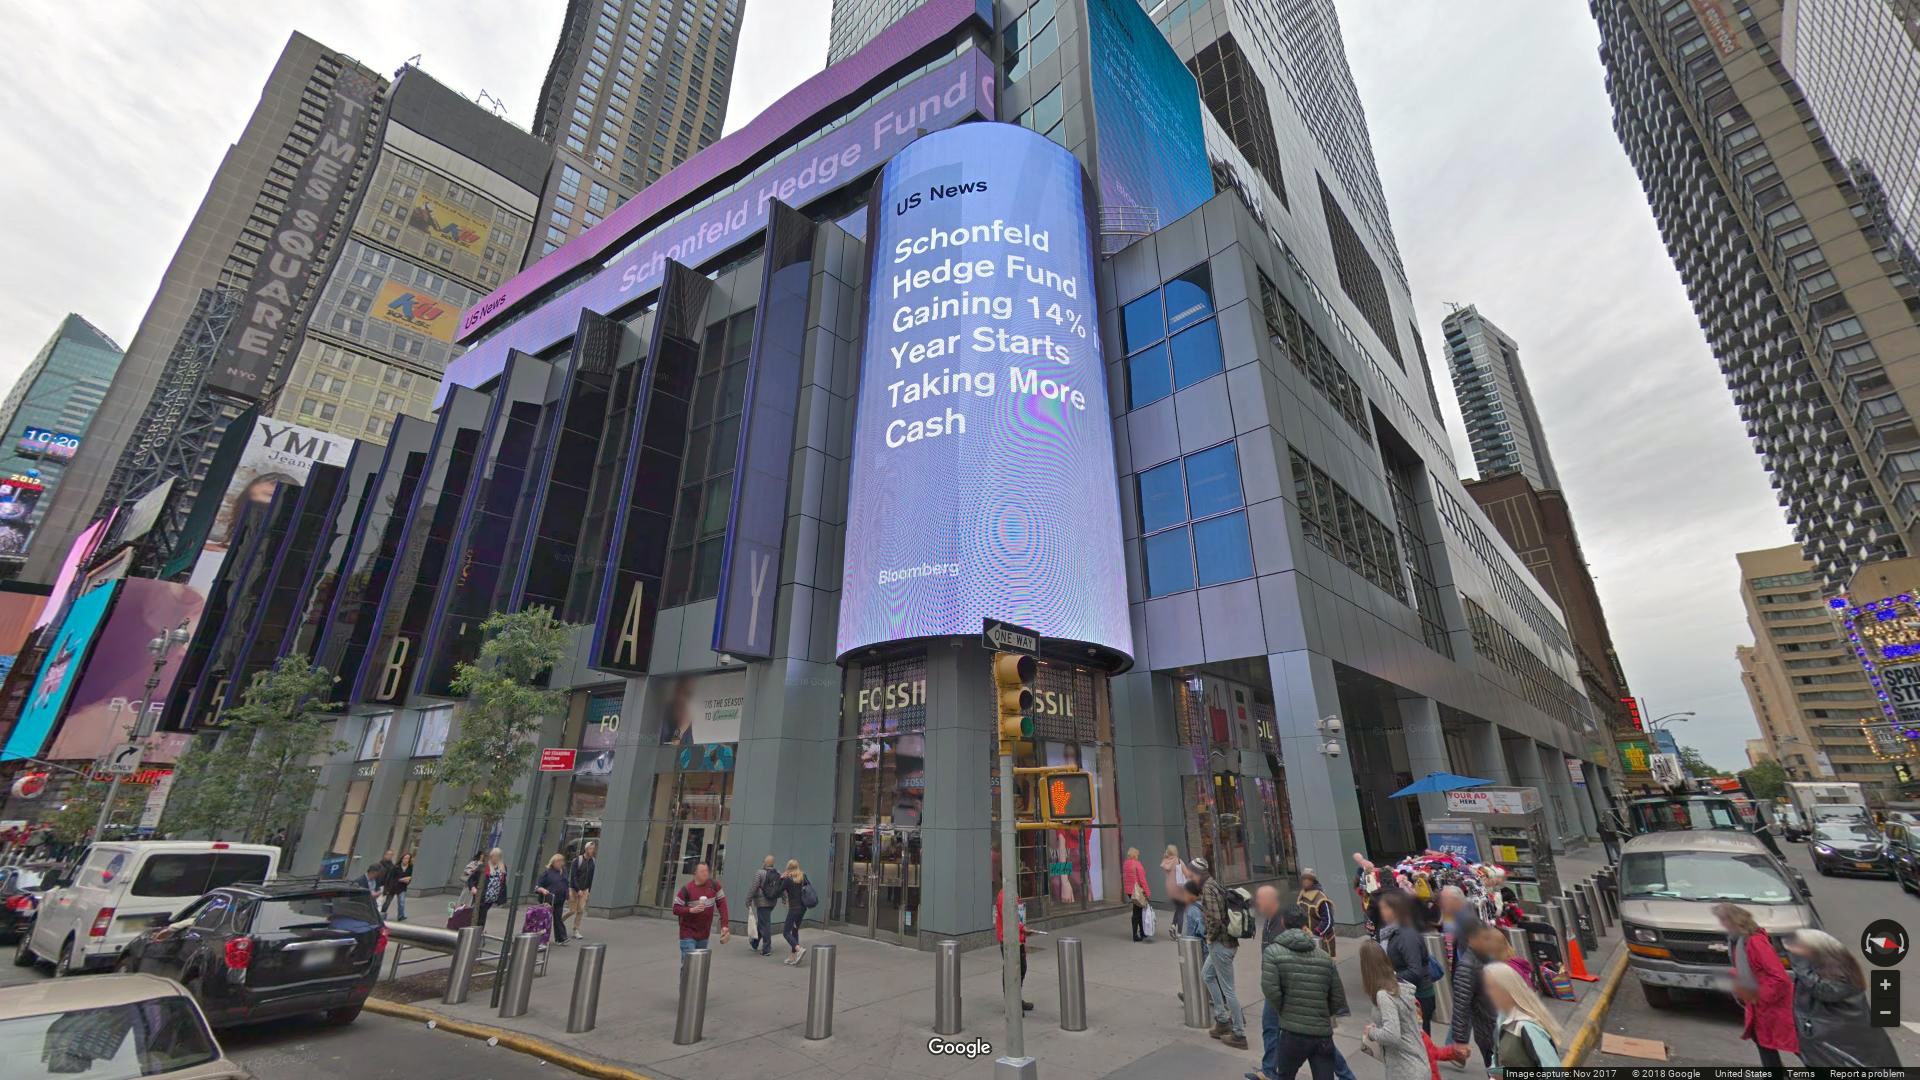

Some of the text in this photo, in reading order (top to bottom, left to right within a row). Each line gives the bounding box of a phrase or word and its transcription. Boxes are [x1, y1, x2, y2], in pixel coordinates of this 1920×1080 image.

[618, 69, 969, 294] Schonfeld Hedge Fund
[896, 177, 988, 218] US News
[238, 93, 365, 356] TIMES SQUARE
[893, 220, 1050, 266] Schonfeld
[892, 255, 1078, 300] Hedge Fund
[465, 294, 506, 329] US News
[891, 290, 1012, 335] Gaining
[1028, 295, 1087, 339] 14%
[890, 327, 1071, 372] Year Starts
[226, 366, 257, 382] NYC
[887, 367, 1087, 412] Taking More
[131, 343, 198, 467] AMERICAN EAGLE
[152, 361, 203, 448] OUTFITTERS
[260, 423, 328, 462] YMI
[884, 409, 967, 450] Cash
[268, 451, 312, 470] Jeans
[877, 560, 961, 587] Bloomberg
[994, 629, 1033, 648] ONE WAY
[111, 764, 133, 772] ONLY
